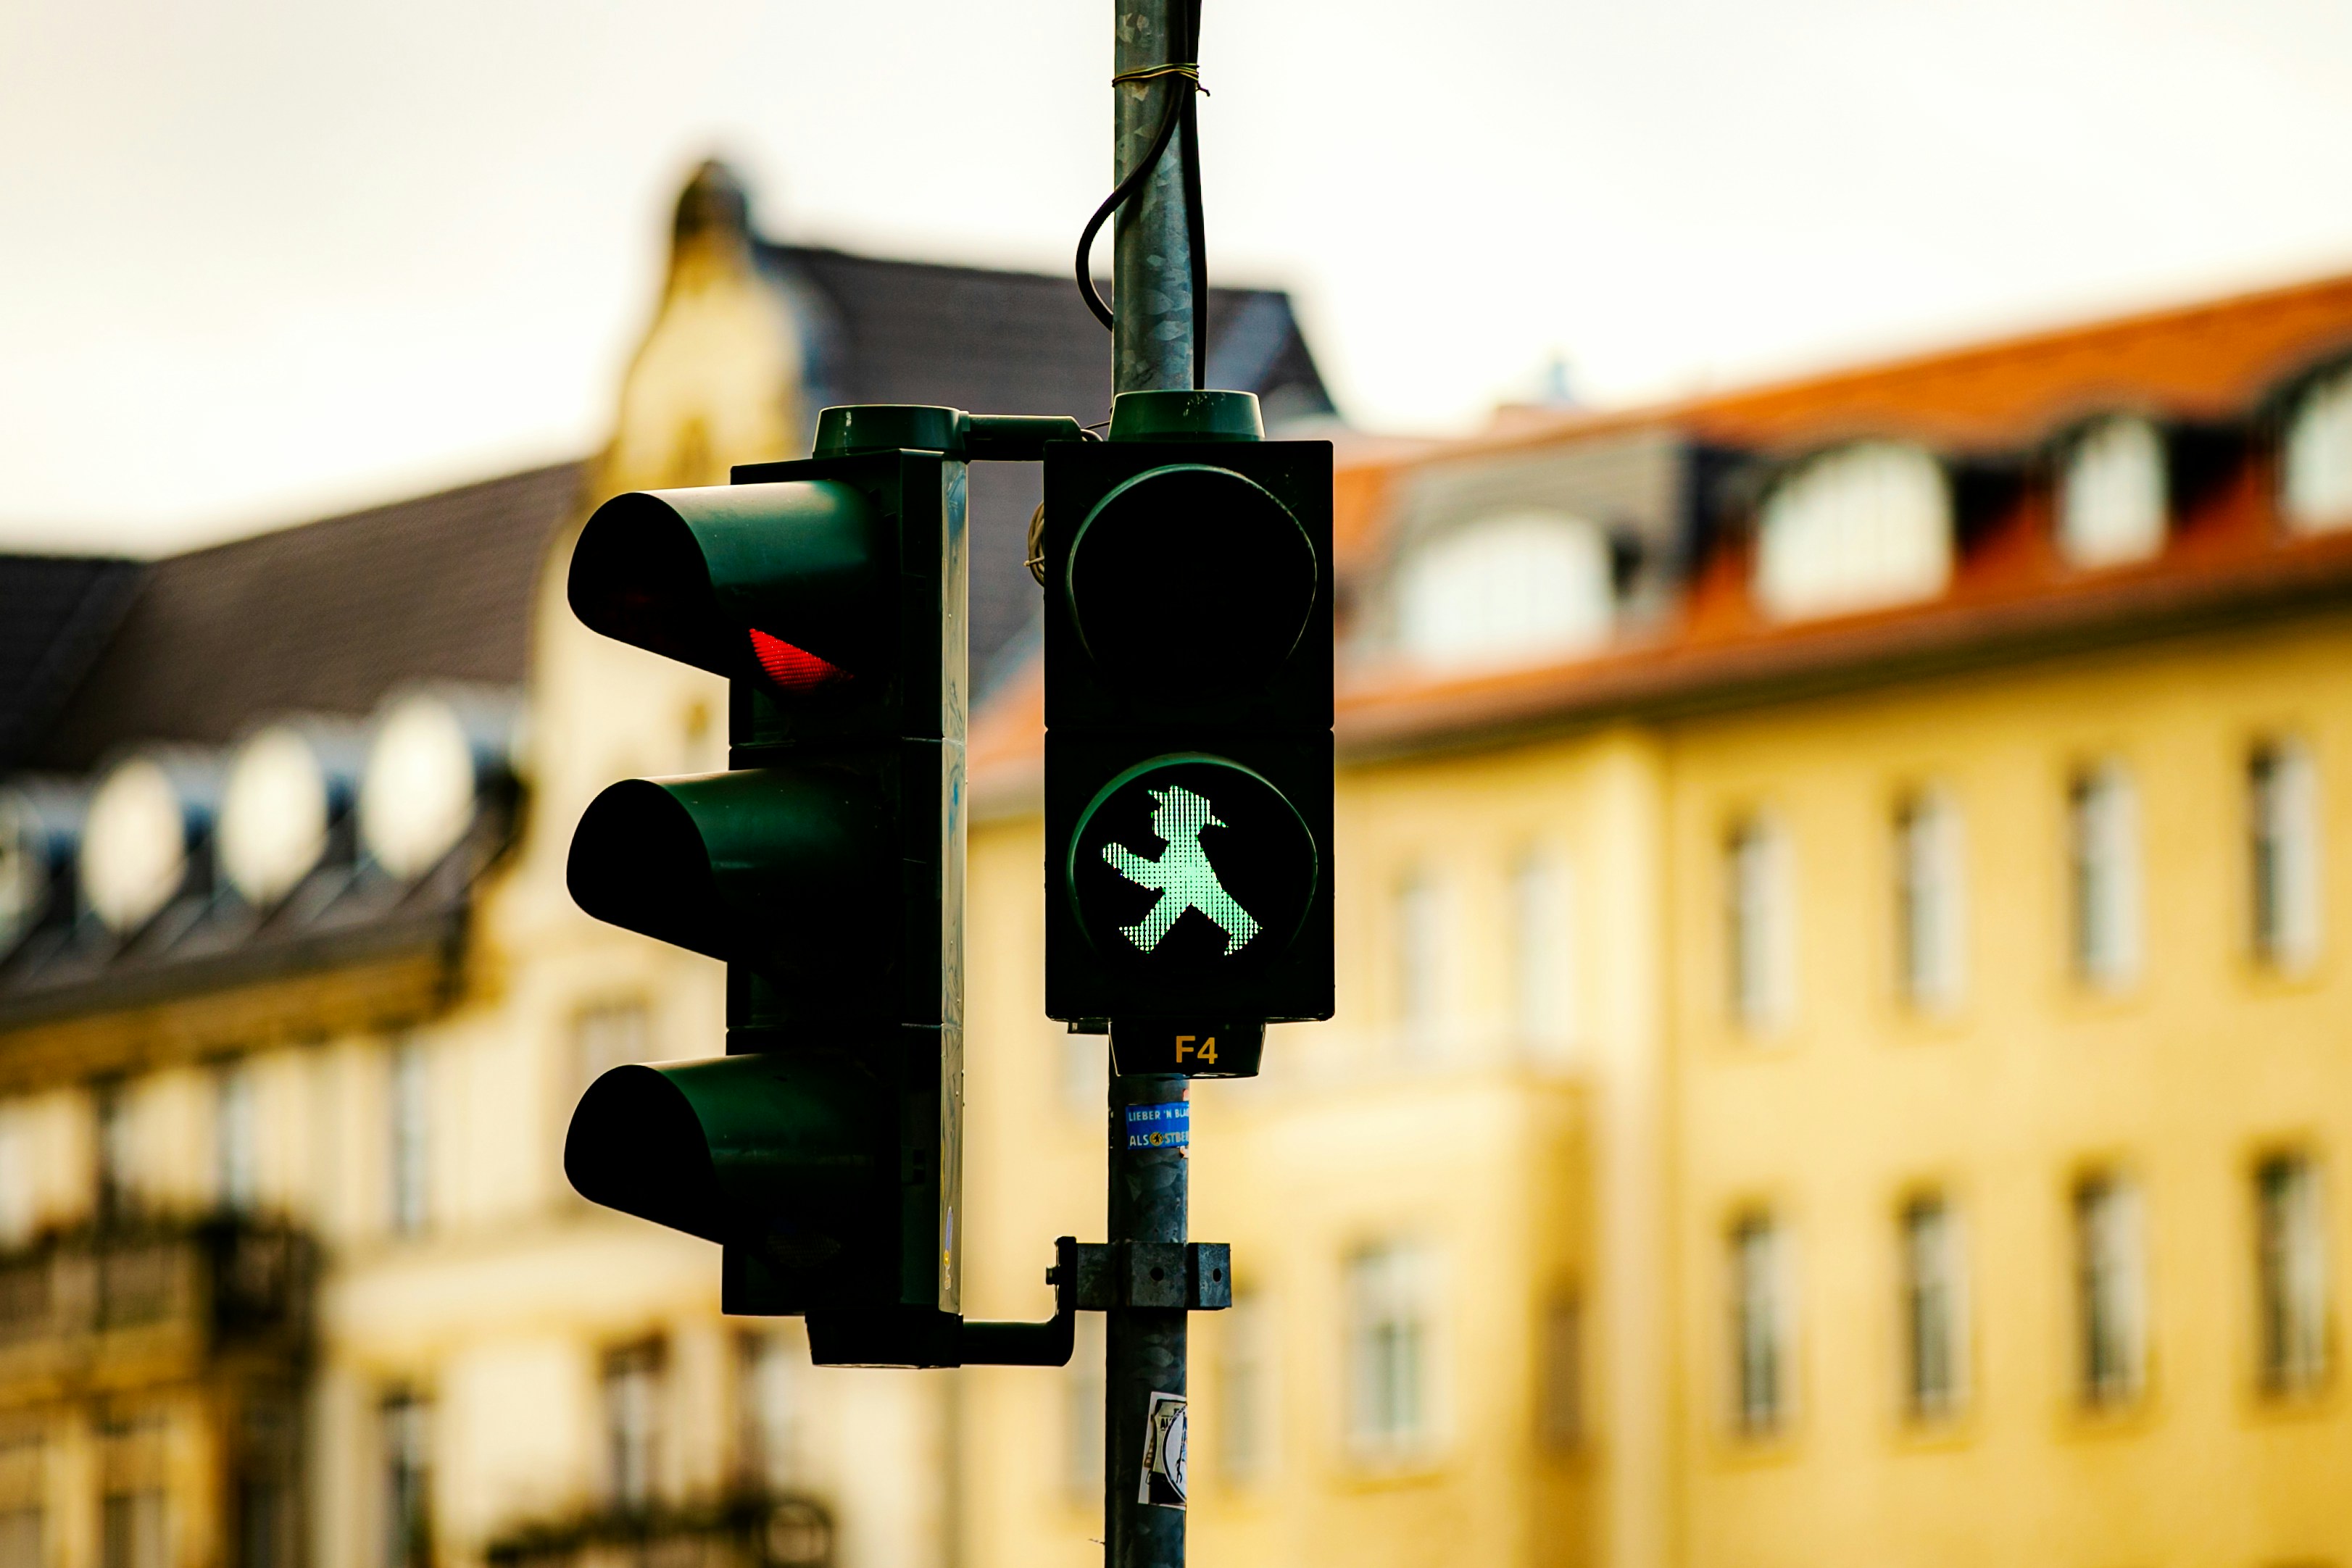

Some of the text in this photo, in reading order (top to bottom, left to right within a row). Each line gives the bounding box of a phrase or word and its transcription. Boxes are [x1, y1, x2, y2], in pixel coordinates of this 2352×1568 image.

[1176, 1035, 1218, 1064] F4
[1129, 1110, 1160, 1122] LIEBER
[1175, 1107, 1189, 1119] BLA
[1129, 1134, 1149, 1146] ALS
